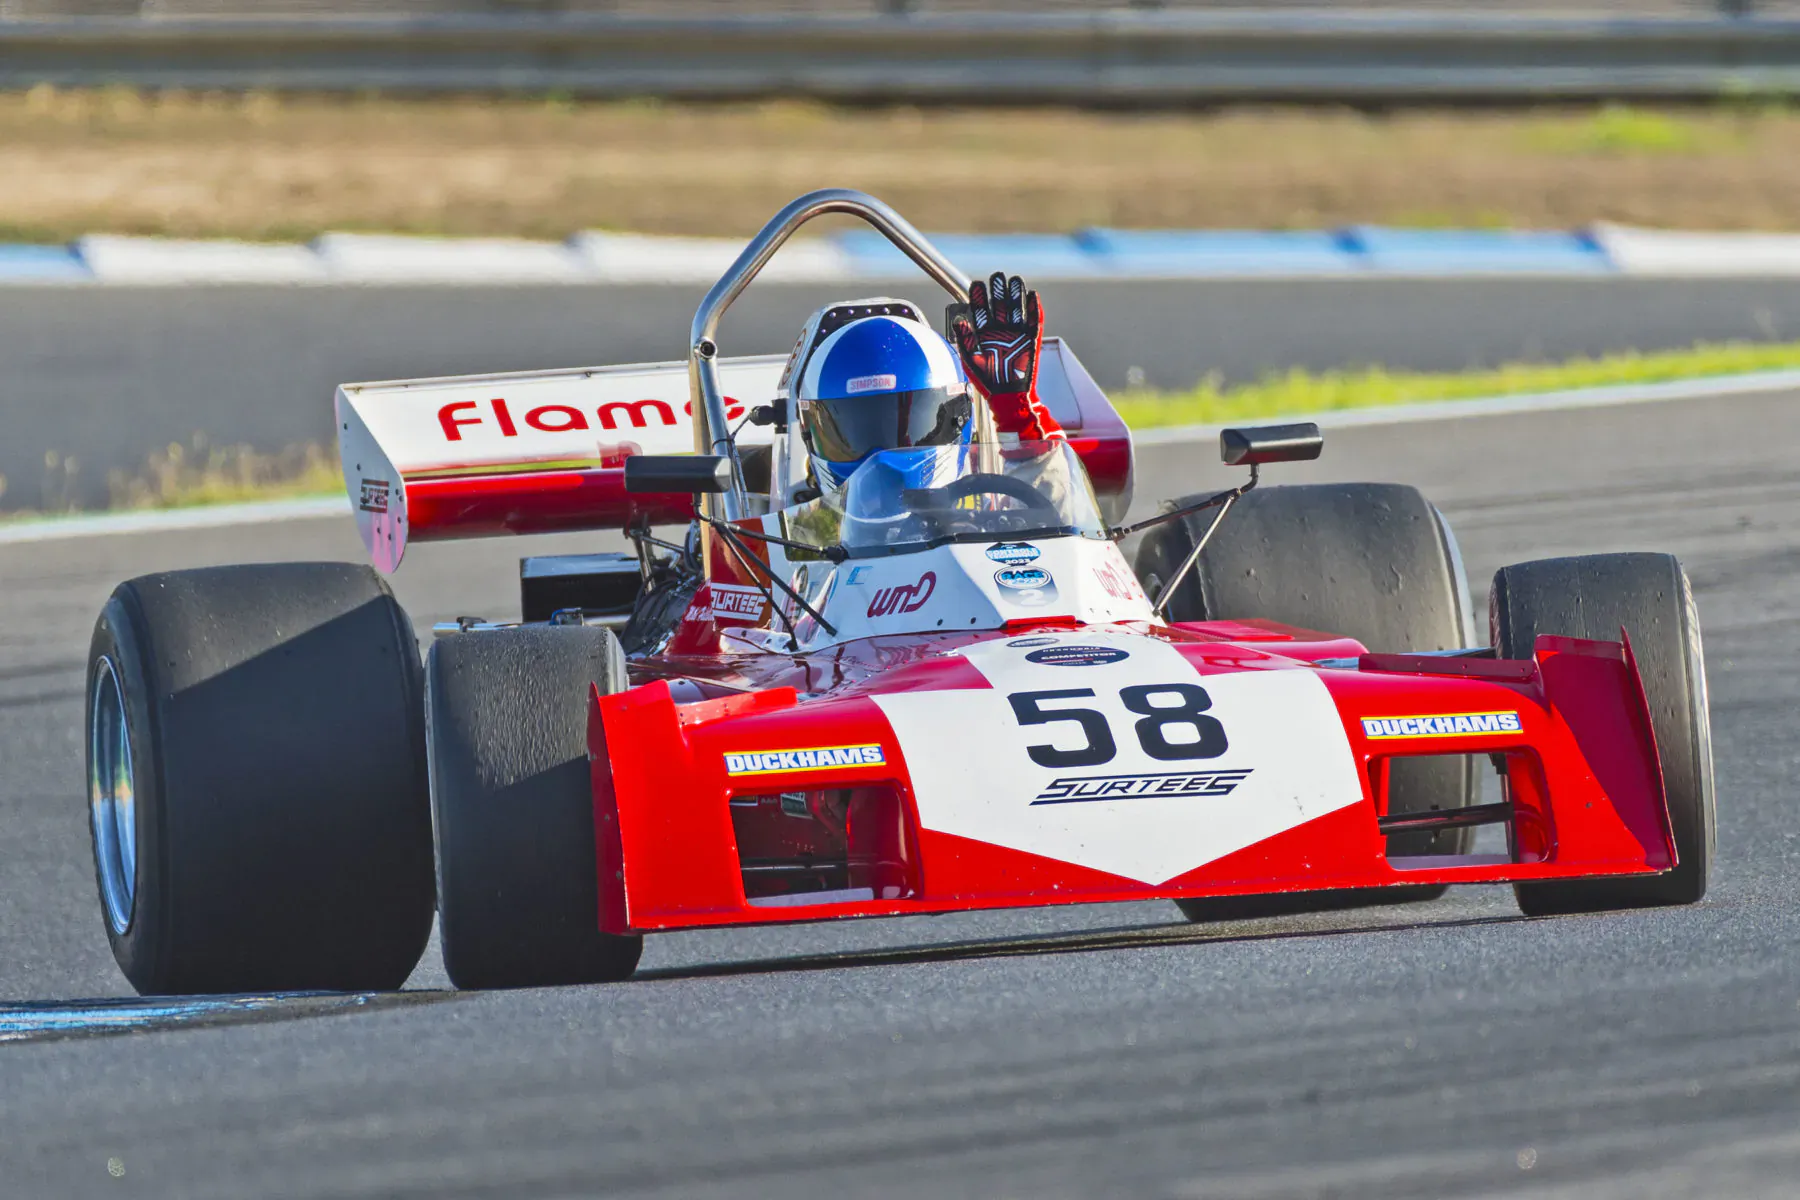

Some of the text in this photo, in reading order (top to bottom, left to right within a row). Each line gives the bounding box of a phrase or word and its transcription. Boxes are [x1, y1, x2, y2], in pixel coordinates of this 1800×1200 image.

[850, 378, 892, 391] SIMPSON
[1001, 569, 1045, 580] RACE
[1018, 589, 1044, 607] 2
[1007, 683, 1229, 769] 58
[1362, 714, 1520, 736] DUCKHAMS
[725, 746, 883, 773] DUCKHAMS
[1029, 769, 1254, 806] SURTEES
